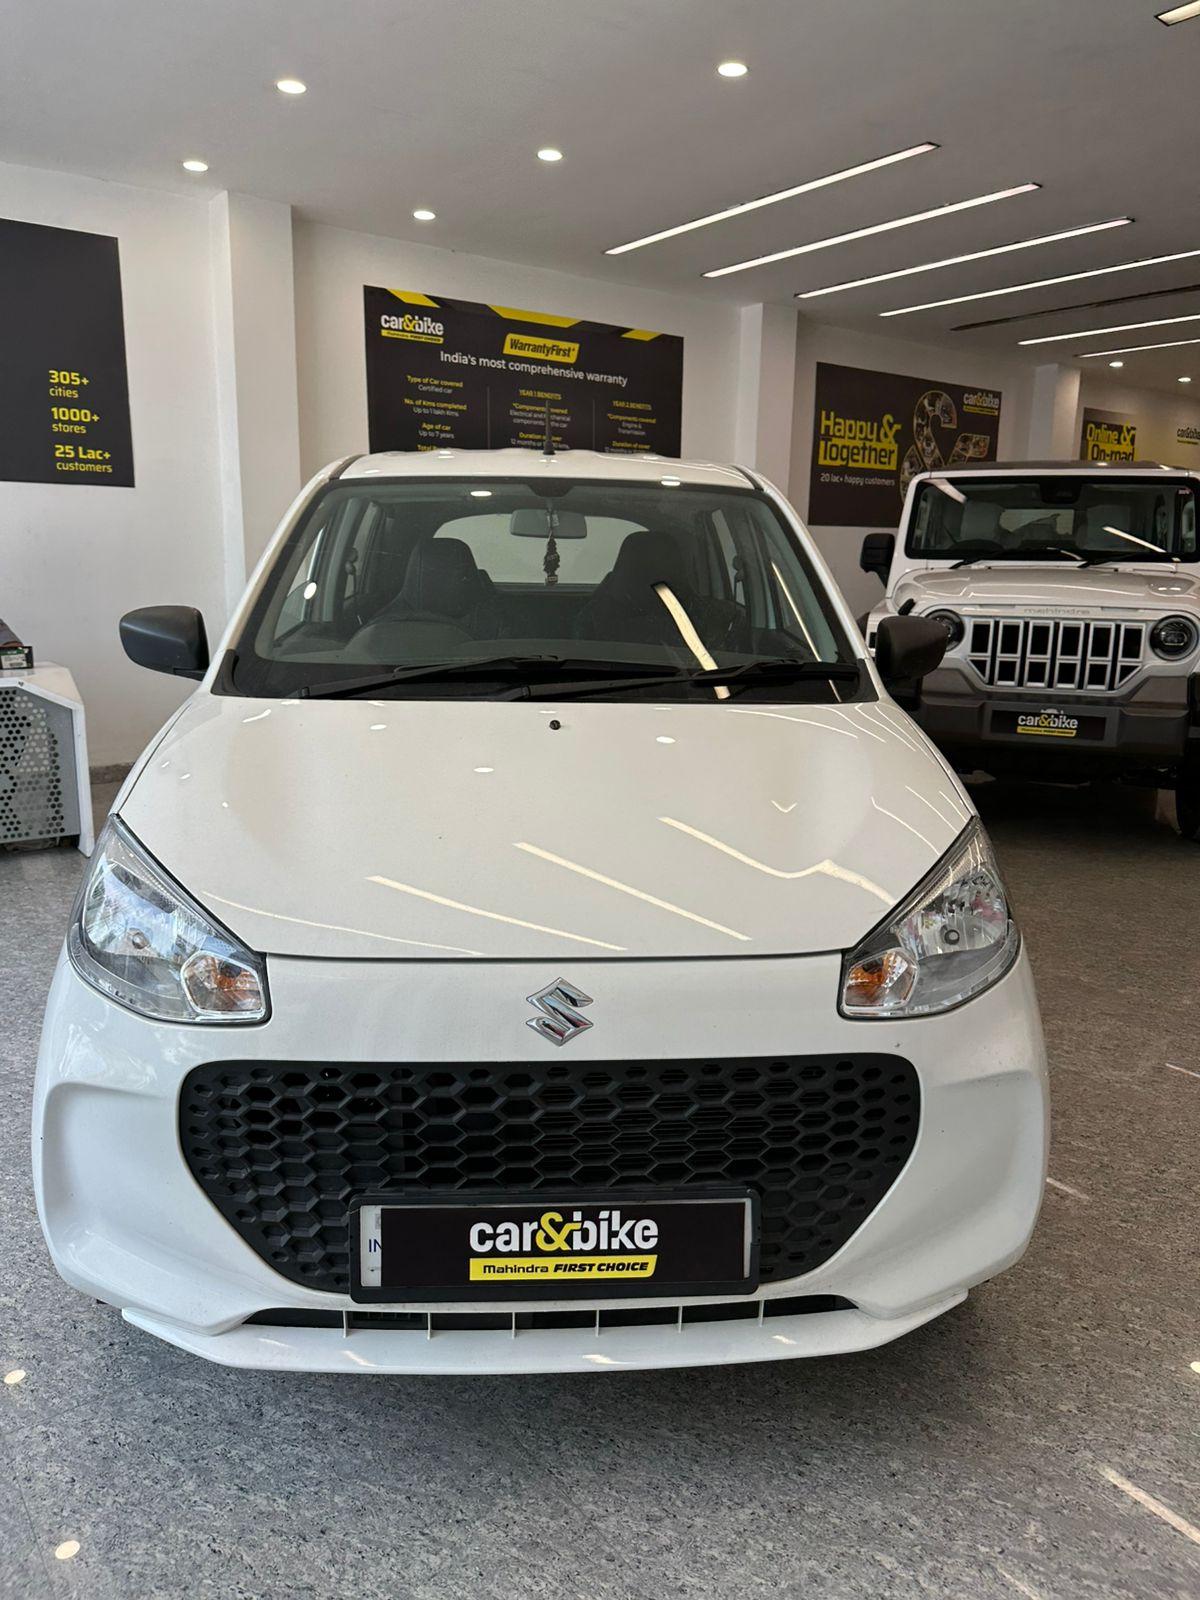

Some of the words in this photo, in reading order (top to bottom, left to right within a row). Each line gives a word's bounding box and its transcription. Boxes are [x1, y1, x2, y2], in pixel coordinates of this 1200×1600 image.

[381, 314, 444, 336] car&bike
[510, 338, 571, 358] WarrantyFirst
[440, 351, 477, 366] India's
[479, 357, 506, 370] most
[508, 361, 585, 380] comprehensive
[586, 372, 628, 387] warranty
[48, 370, 89, 385] 305+
[49, 386, 79, 398] cities
[51, 407, 100, 422] 1000+
[52, 423, 87, 434] stores
[820, 410, 878, 443] Happy
[880, 414, 902, 445] &
[1087, 423, 1119, 444] Online
[1121, 421, 1136, 447] &
[55, 445, 75, 458] 25
[78, 447, 111, 460] Lac+
[821, 439, 895, 467] Together
[56, 463, 112, 473] customers
[820, 473, 830, 482] 20
[844, 474, 864, 486] happy
[865, 477, 895, 486] customers
[1018, 714, 1078, 729] car&bike
[469, 1210, 659, 1253] car&bike
[483, 1264, 549, 1274] Mahindra
[553, 1263, 596, 1273] FIRST
[597, 1262, 650, 1272] CHOICE
